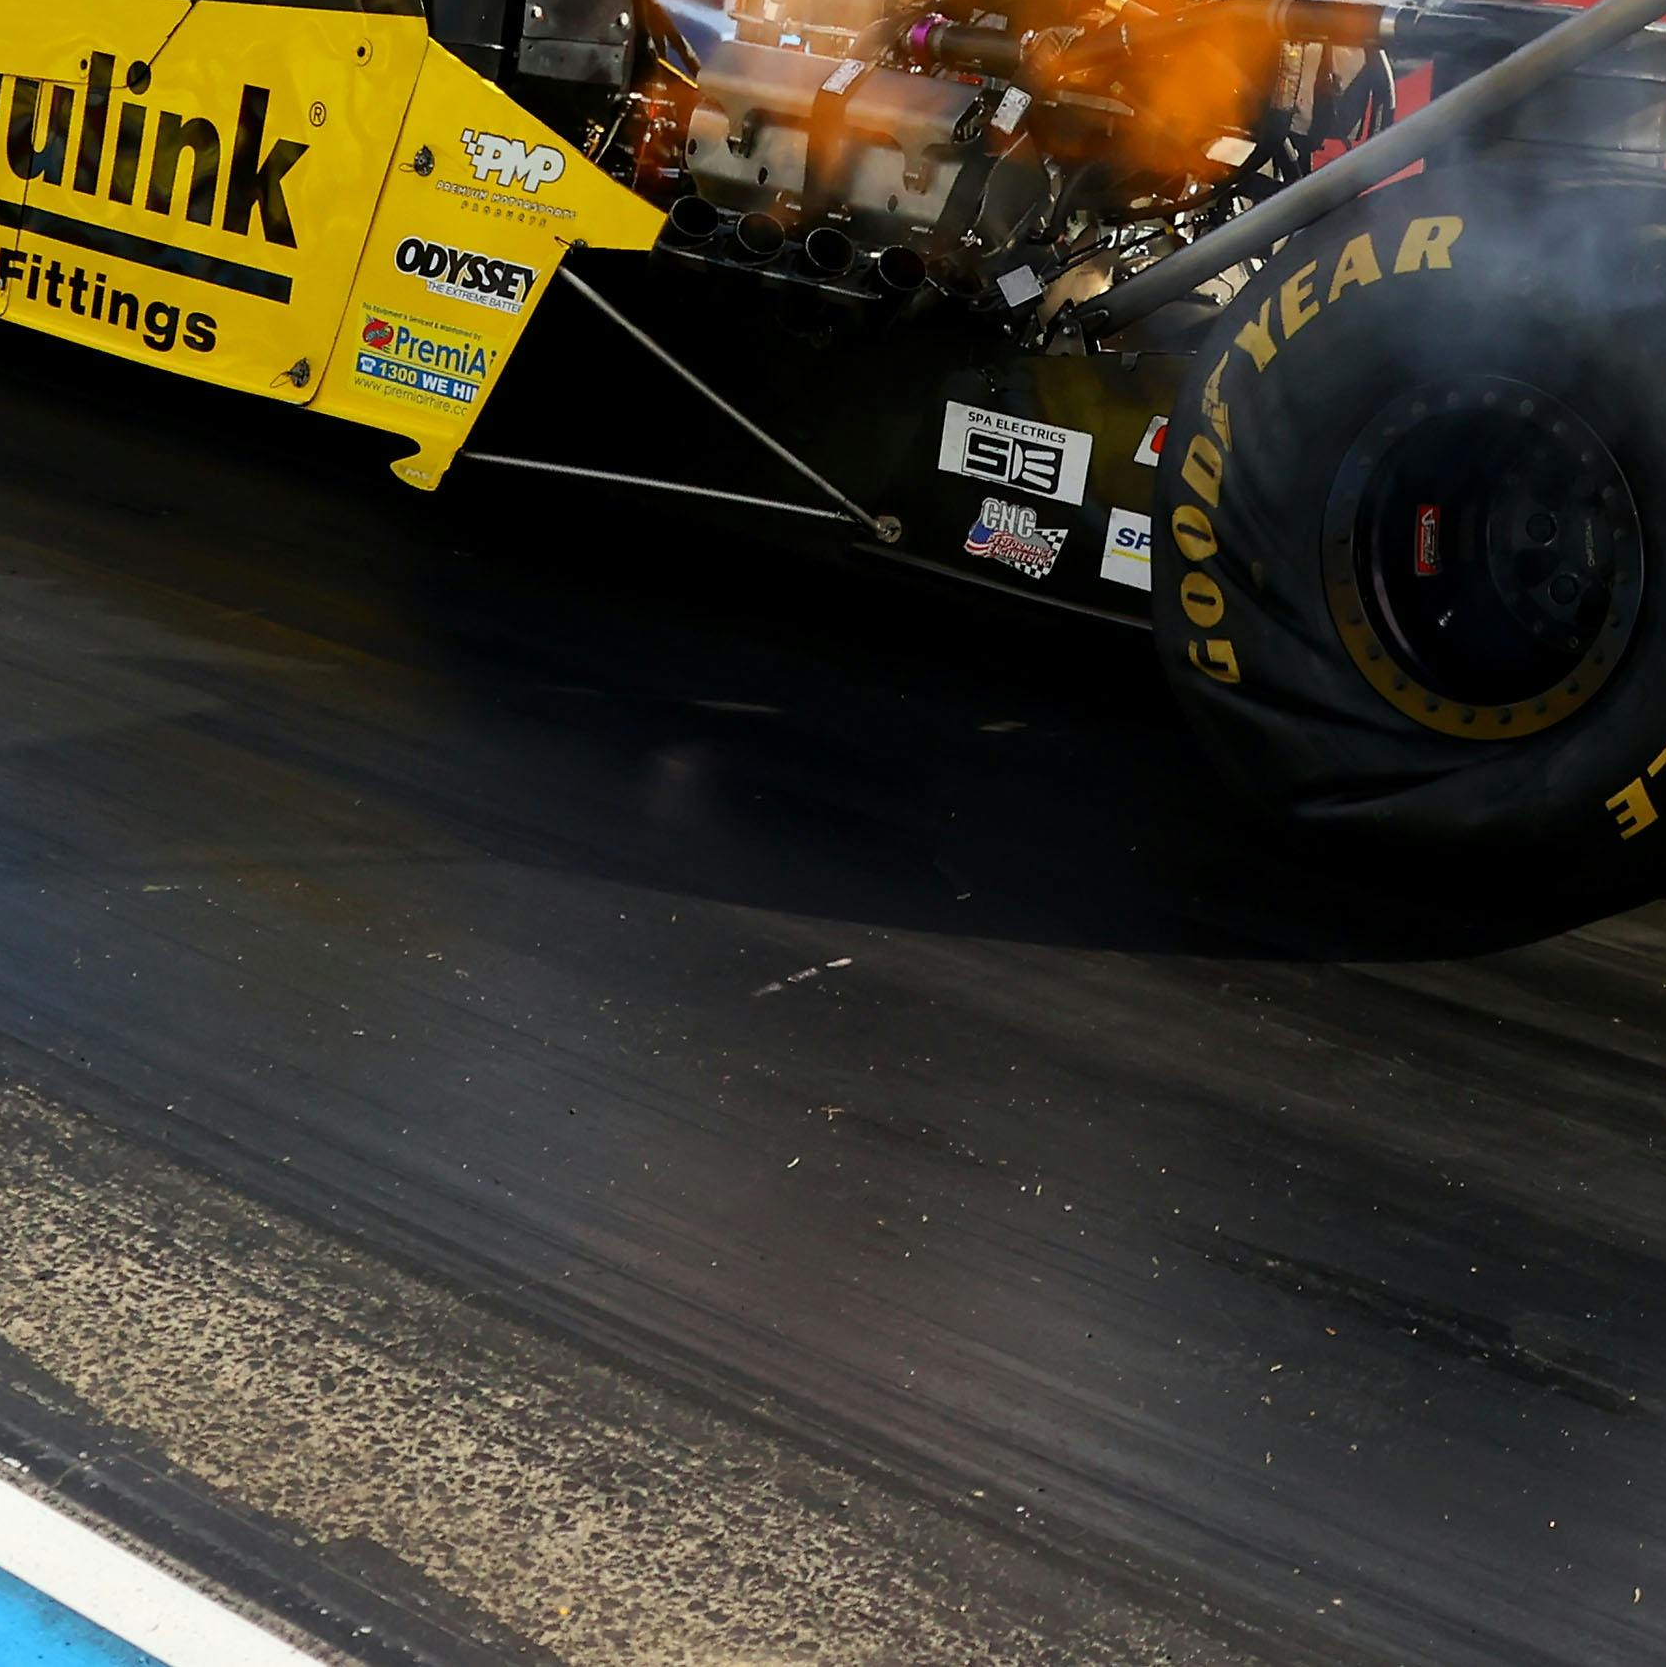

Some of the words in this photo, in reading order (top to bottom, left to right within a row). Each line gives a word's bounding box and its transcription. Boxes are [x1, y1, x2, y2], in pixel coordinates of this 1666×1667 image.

[467, 132, 566, 193] PMP
[436, 180, 489, 200] PREMIUM
[491, 194, 577, 221] MOTORSPORTS
[395, 236, 540, 304] ODYSSEY
[427, 280, 445, 292] THE
[445, 284, 488, 305] EXTREME
[379, 363, 417, 385] 1300
[422, 373, 448, 394] WE
[968, 410, 992, 427] SPA
[995, 417, 1067, 445] ELECTRICS
[982, 497, 1038, 539] CNC
[987, 544, 1051, 567] ENGINEERING
[988, 533, 1054, 558] PERFORMANCE
